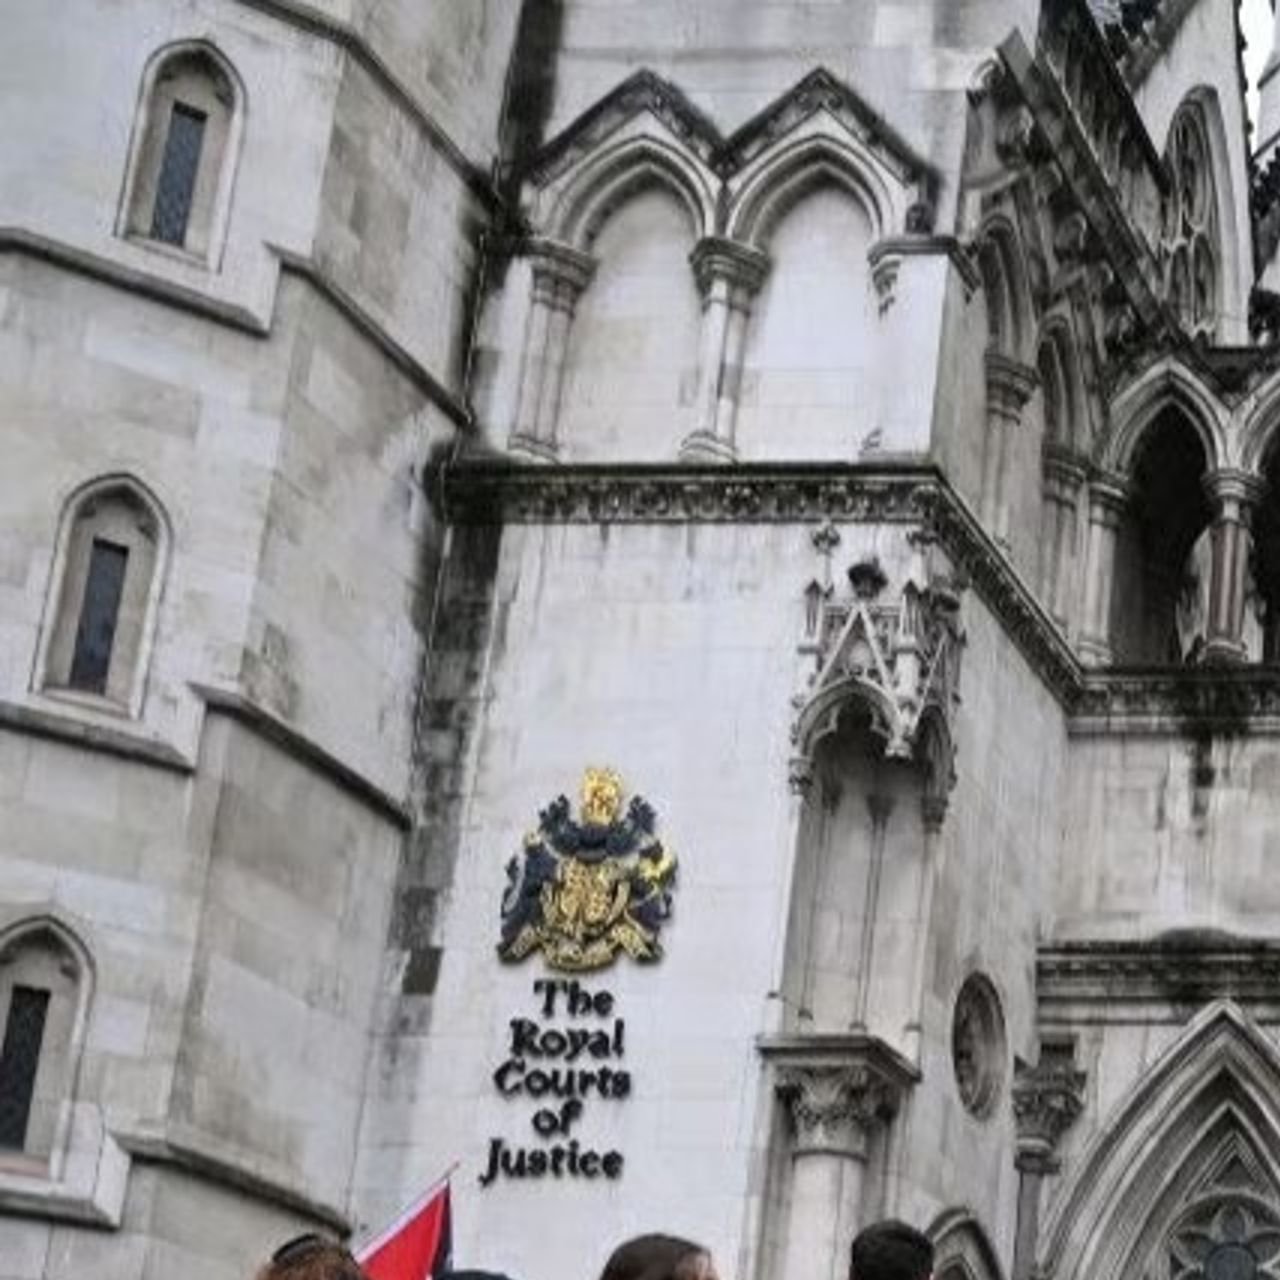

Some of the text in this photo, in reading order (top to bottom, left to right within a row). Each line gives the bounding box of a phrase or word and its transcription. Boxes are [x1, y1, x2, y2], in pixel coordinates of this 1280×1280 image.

[534, 980, 614, 1019] The
[509, 1018, 625, 1063] Royal
[493, 1060, 631, 1099] Courts
[531, 1100, 583, 1138] of
[479, 1138, 624, 1188] Justice
